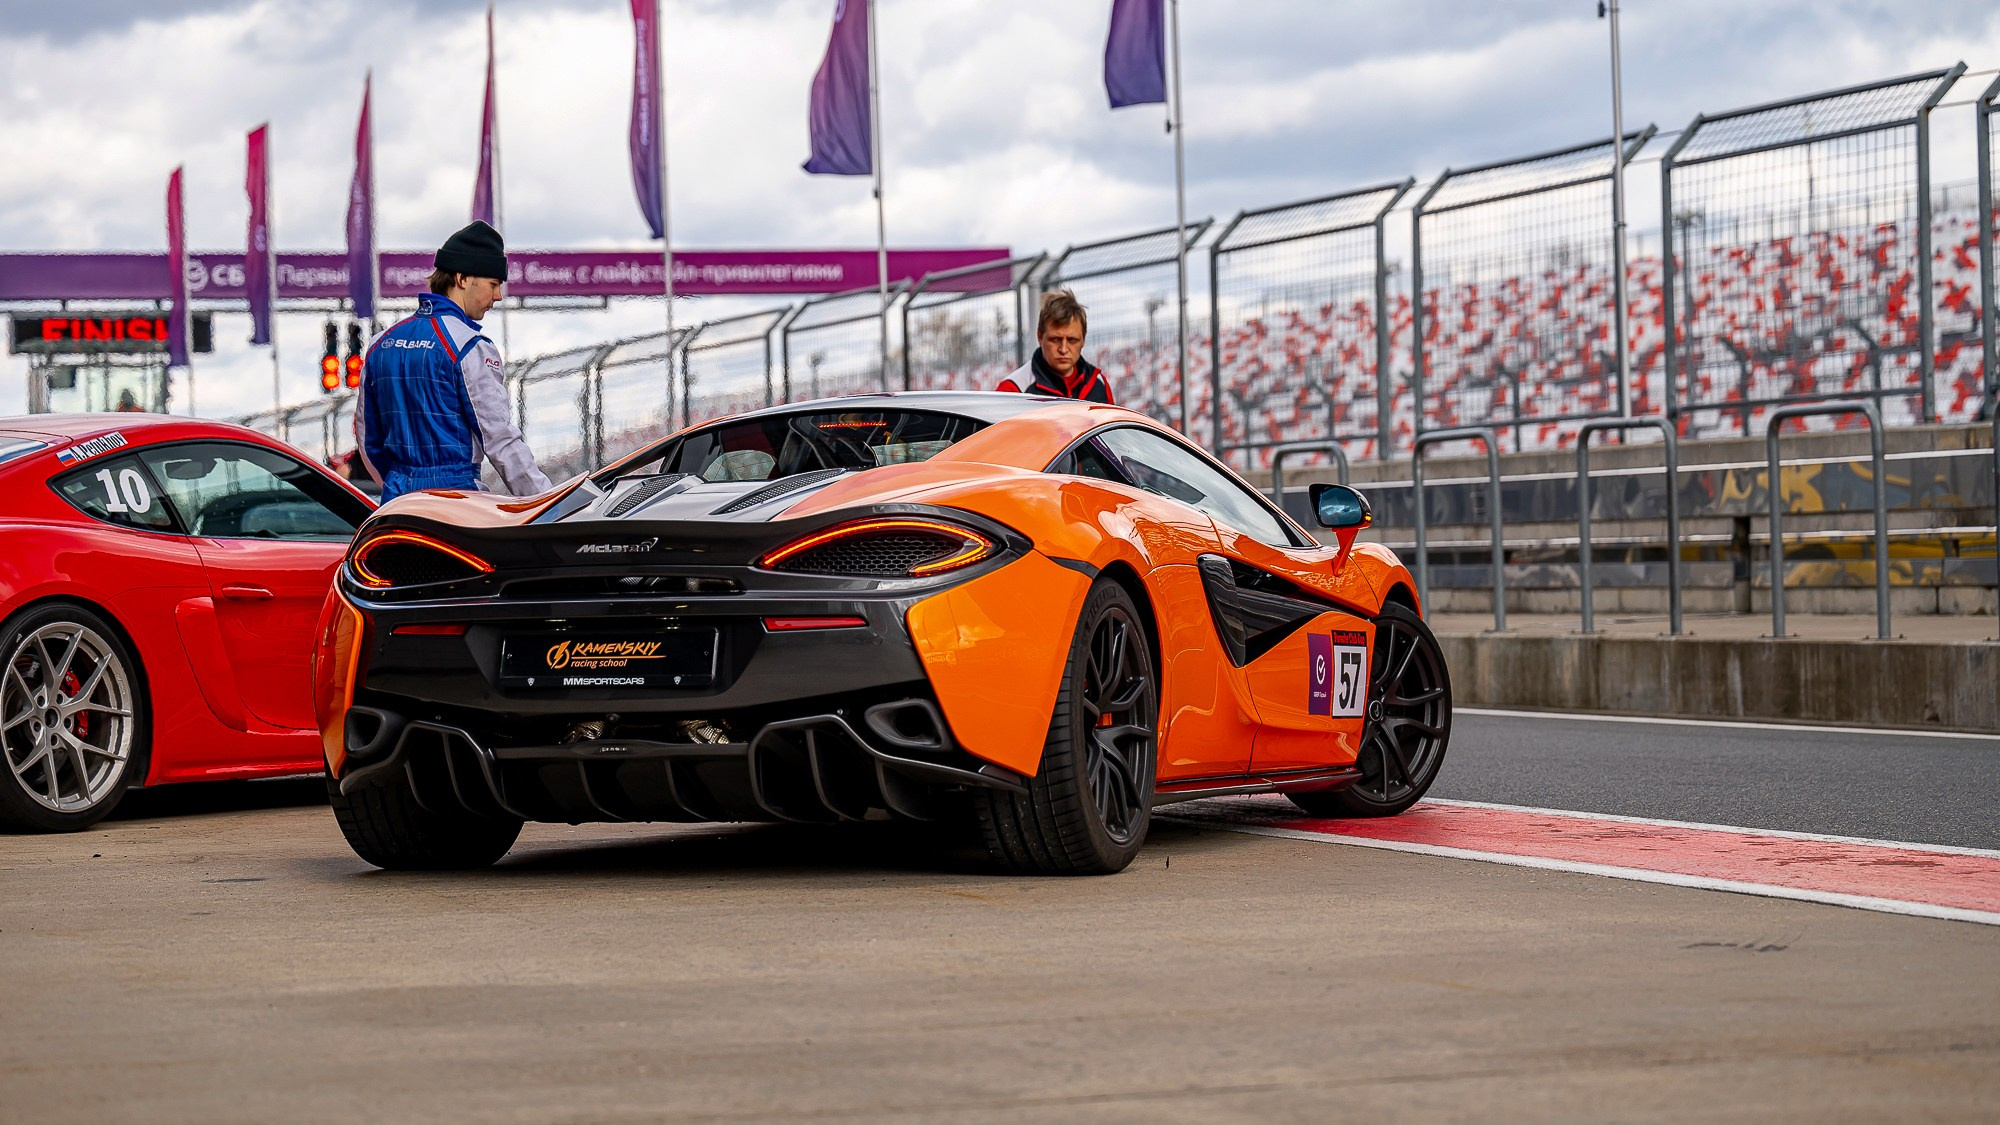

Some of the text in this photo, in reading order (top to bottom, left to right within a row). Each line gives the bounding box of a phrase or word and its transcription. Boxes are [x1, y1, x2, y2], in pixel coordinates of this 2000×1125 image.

[211, 264, 246, 287] СБ
[277, 264, 349, 289] Первы
[592, 261, 843, 286] лайфстйл-привилегиями
[394, 339, 436, 350] SUBARU
[95, 468, 151, 514] 10
[571, 641, 662, 656] KAMENSKIY
[571, 659, 627, 669] racing school
[563, 677, 645, 686] MMSPORTSCARS
[1339, 652, 1361, 709] 57
